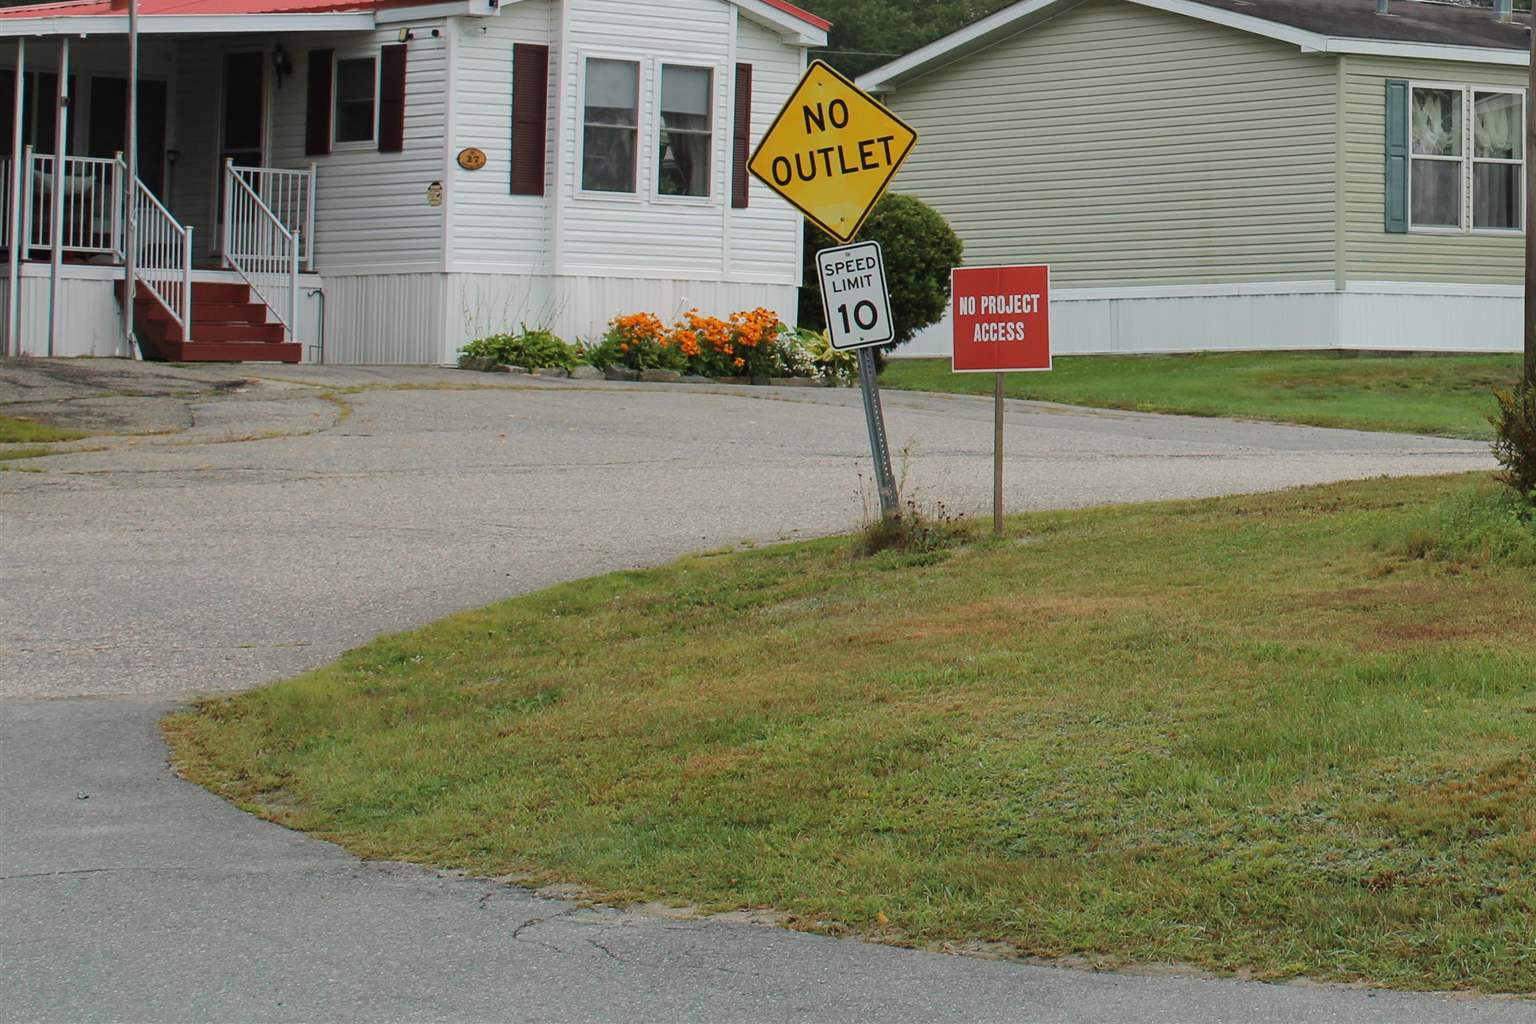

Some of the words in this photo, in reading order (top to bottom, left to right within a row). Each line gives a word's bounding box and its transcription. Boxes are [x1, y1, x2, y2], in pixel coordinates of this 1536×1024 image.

[803, 98, 849, 134] NO
[771, 135, 894, 186] OUTLET
[824, 256, 876, 276] SPEED
[832, 274, 873, 293] LIMIT
[959, 296, 976, 316] NO
[980, 293, 1041, 315] PROJECT
[837, 299, 878, 334] 10
[973, 321, 1026, 342] ACCESS
